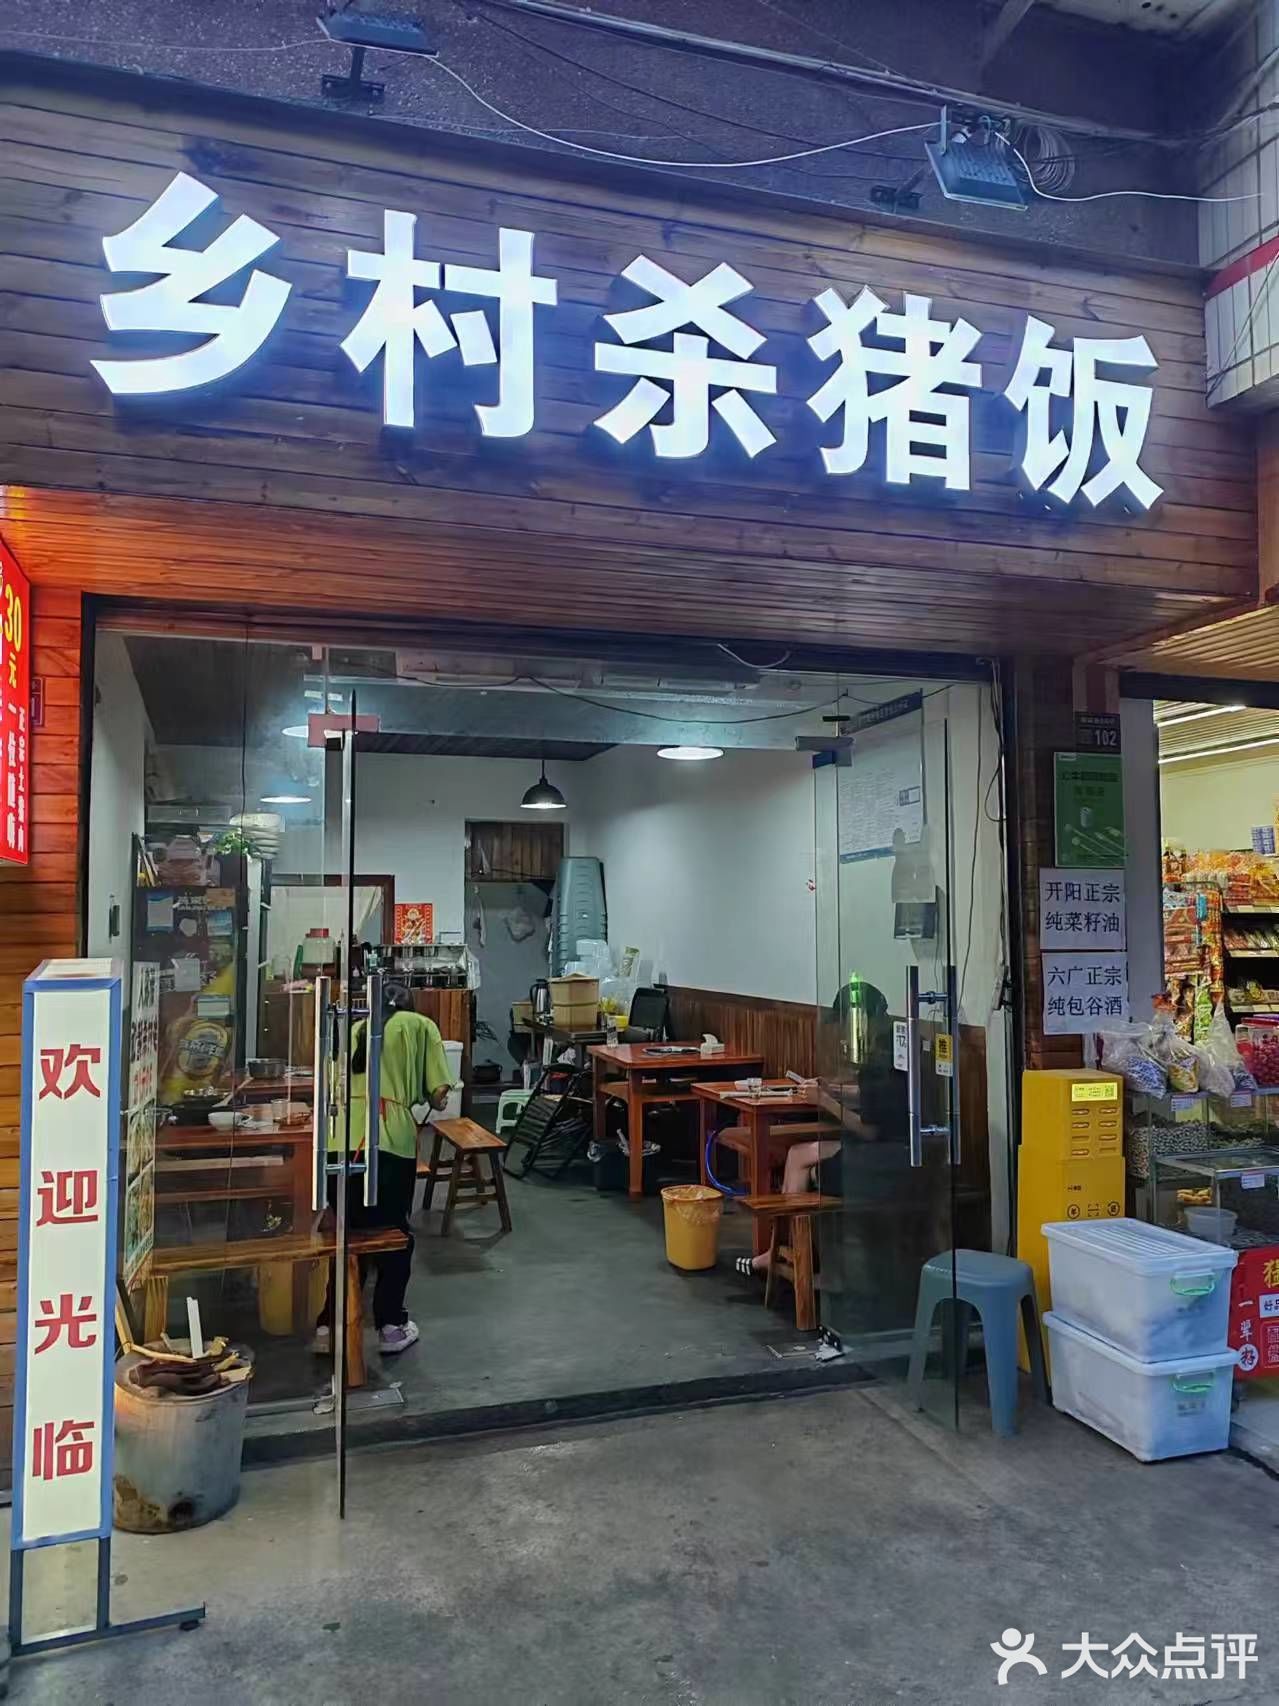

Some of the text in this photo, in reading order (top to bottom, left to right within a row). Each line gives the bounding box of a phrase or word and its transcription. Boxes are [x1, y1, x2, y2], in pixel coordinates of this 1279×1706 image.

[91, 171, 1164, 510] 乡村杀猪饭
[1095, 729, 1117, 746] 102
[1045, 881, 1120, 903] 开阳正宗
[1045, 911, 1120, 933] 纯菜籽油
[1047, 966, 1122, 987] 六广正宗
[1047, 995, 1123, 1017] 纯包谷酒
[32, 1043, 101, 1481] 欢迎光临
